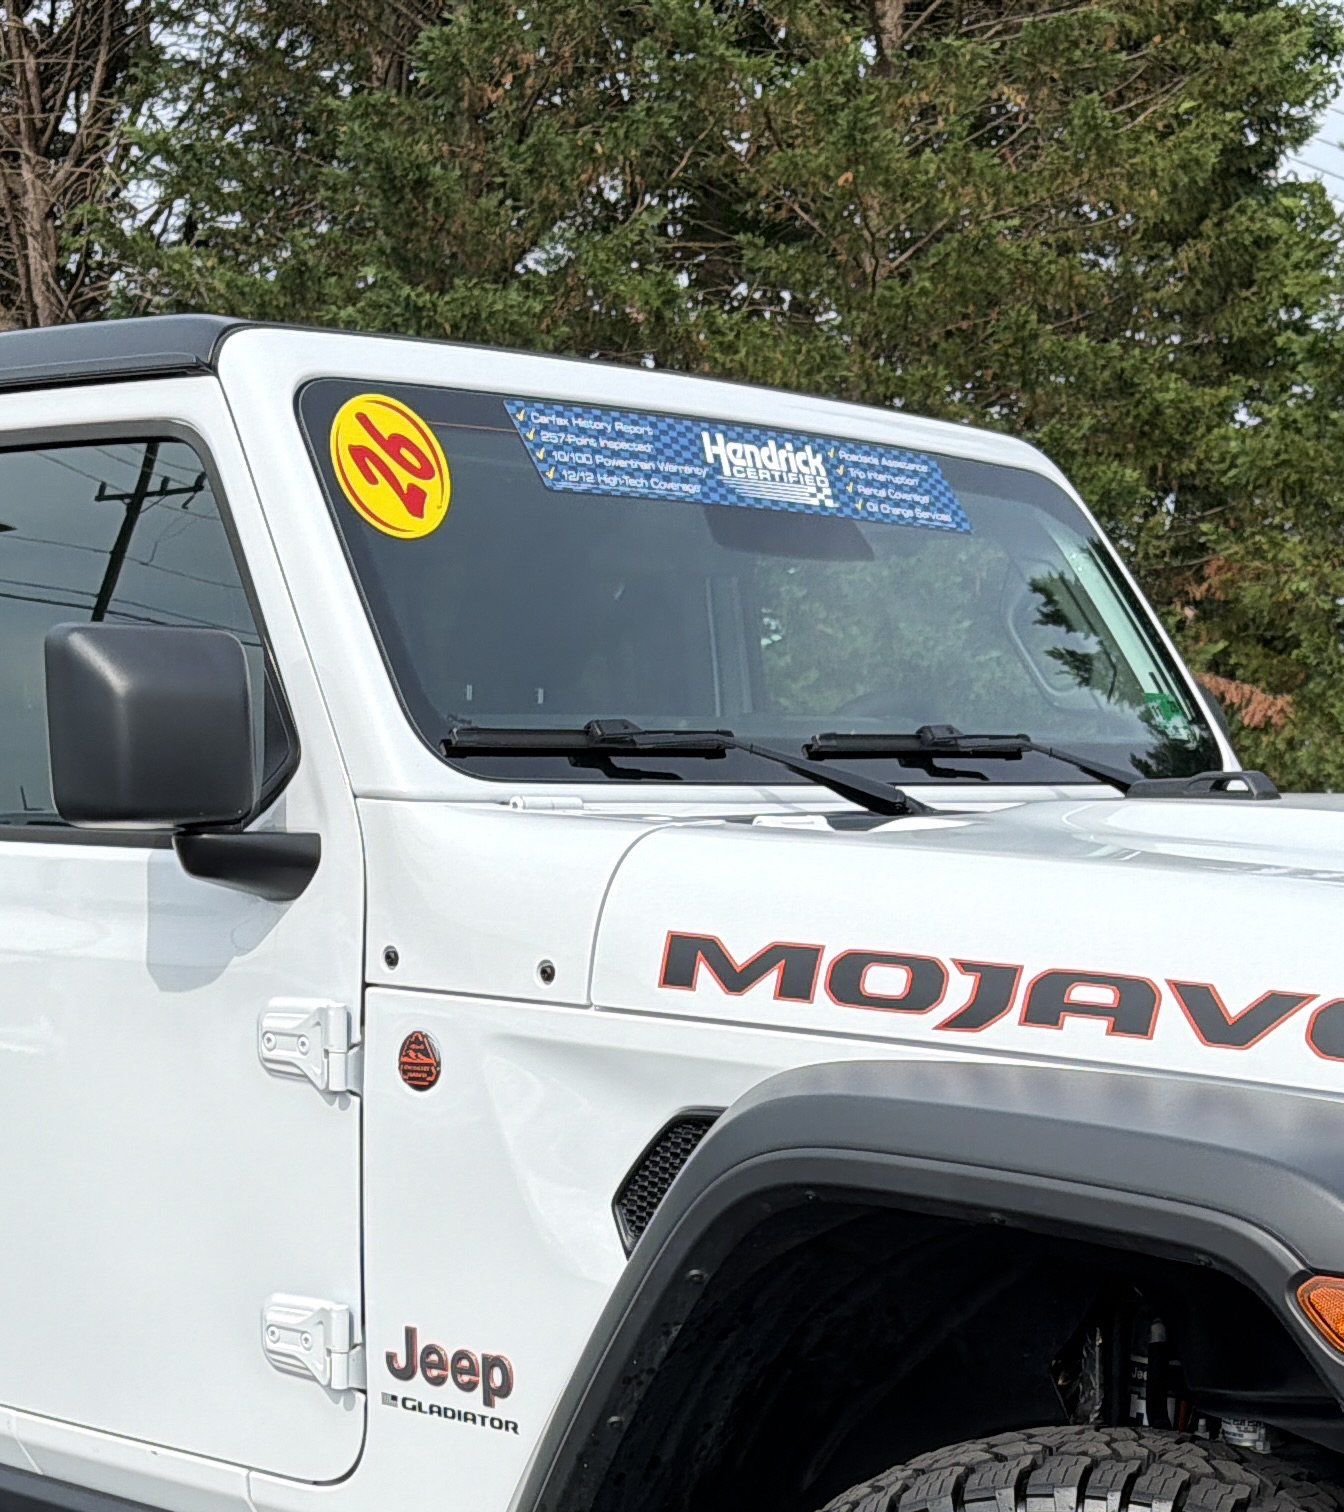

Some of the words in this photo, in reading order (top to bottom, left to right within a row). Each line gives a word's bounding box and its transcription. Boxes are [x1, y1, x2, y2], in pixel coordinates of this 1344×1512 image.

[530, 411, 570, 427] Carfax
[571, 417, 612, 434] History
[614, 422, 654, 436] Report
[348, 412, 435, 519] 26
[552, 450, 593, 465] 10/100
[595, 455, 656, 471] Powertrain
[657, 460, 709, 479] Warranty
[701, 431, 828, 477] Hendrick
[561, 469, 595, 483] 12/12
[650, 477, 702, 495] Coverage
[733, 466, 830, 489] CERTIFIED
[385, 1325, 514, 1409] Jeep
[401, 1396, 520, 1436] GLADIATOR
